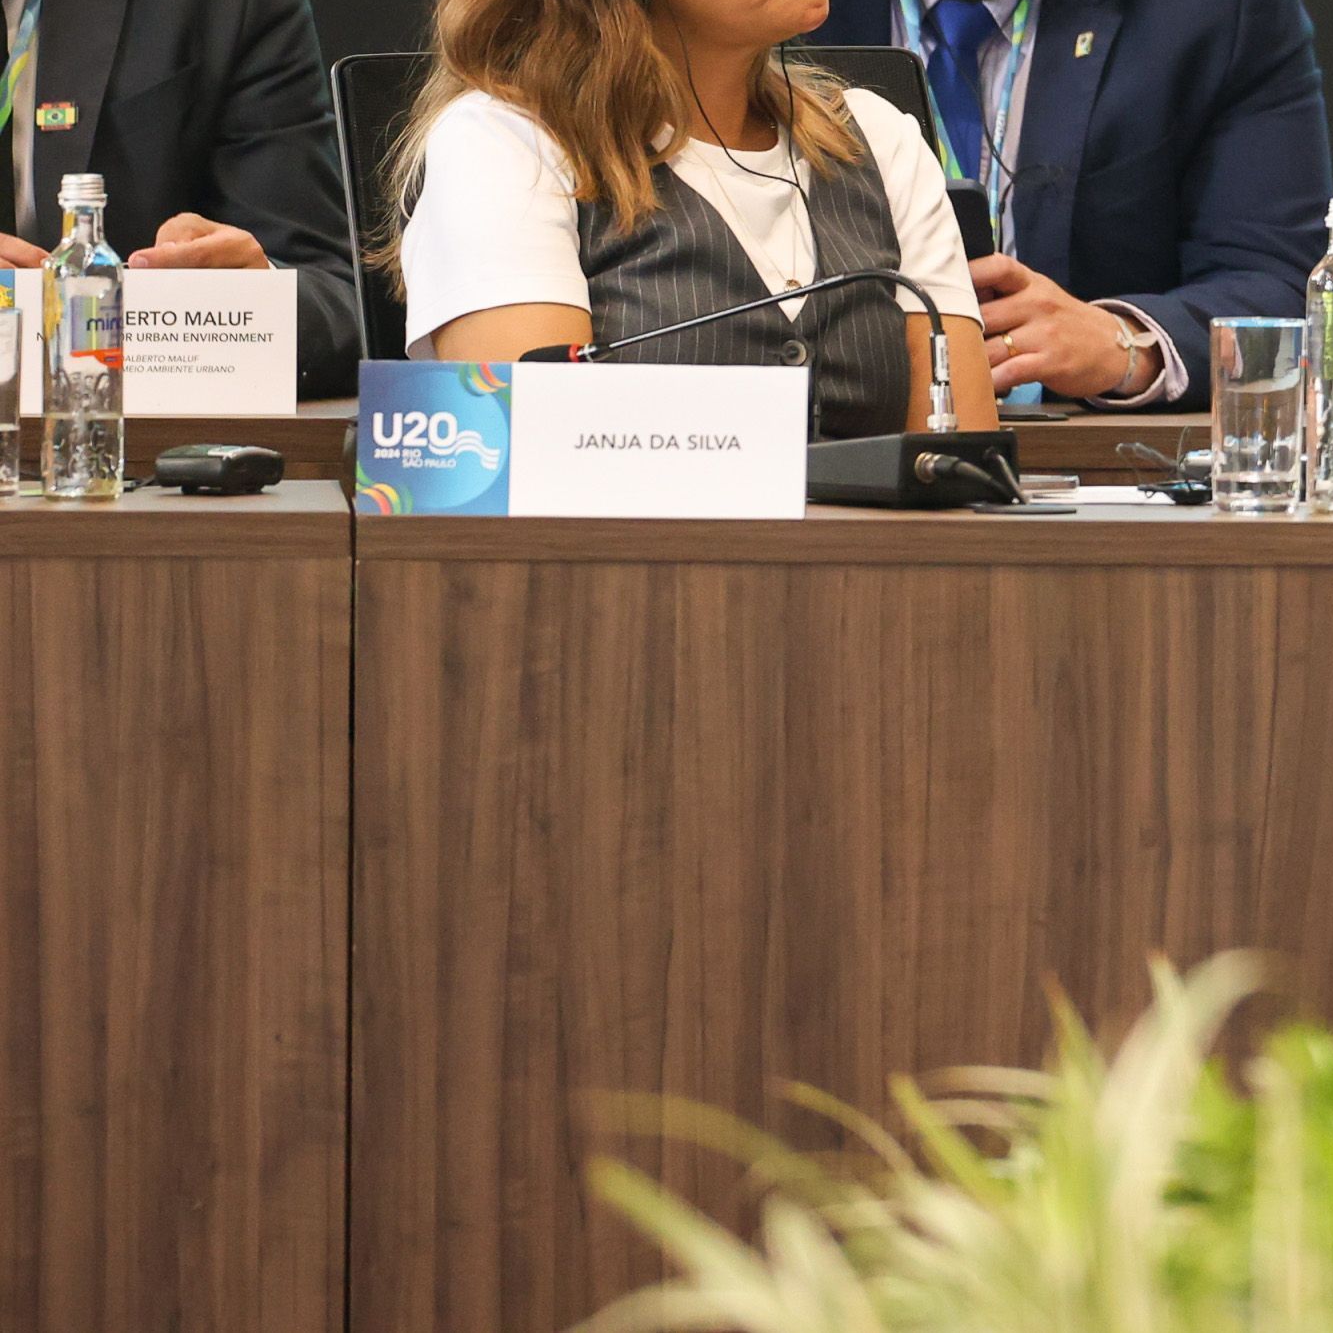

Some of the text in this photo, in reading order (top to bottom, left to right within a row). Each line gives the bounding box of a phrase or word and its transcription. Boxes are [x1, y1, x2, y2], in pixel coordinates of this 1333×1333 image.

[185, 311, 254, 326] MALUF
[136, 333, 179, 343] URBAN
[183, 333, 274, 343] ENVIRONMENT
[167, 355, 199, 363] MALUF
[146, 365, 193, 373] AMBIENTE
[195, 365, 236, 373] URBANO
[372, 411, 458, 448] U20
[574, 434, 742, 450] JANJA DA SILVA
[374, 448, 422, 459] 2024 RIO
